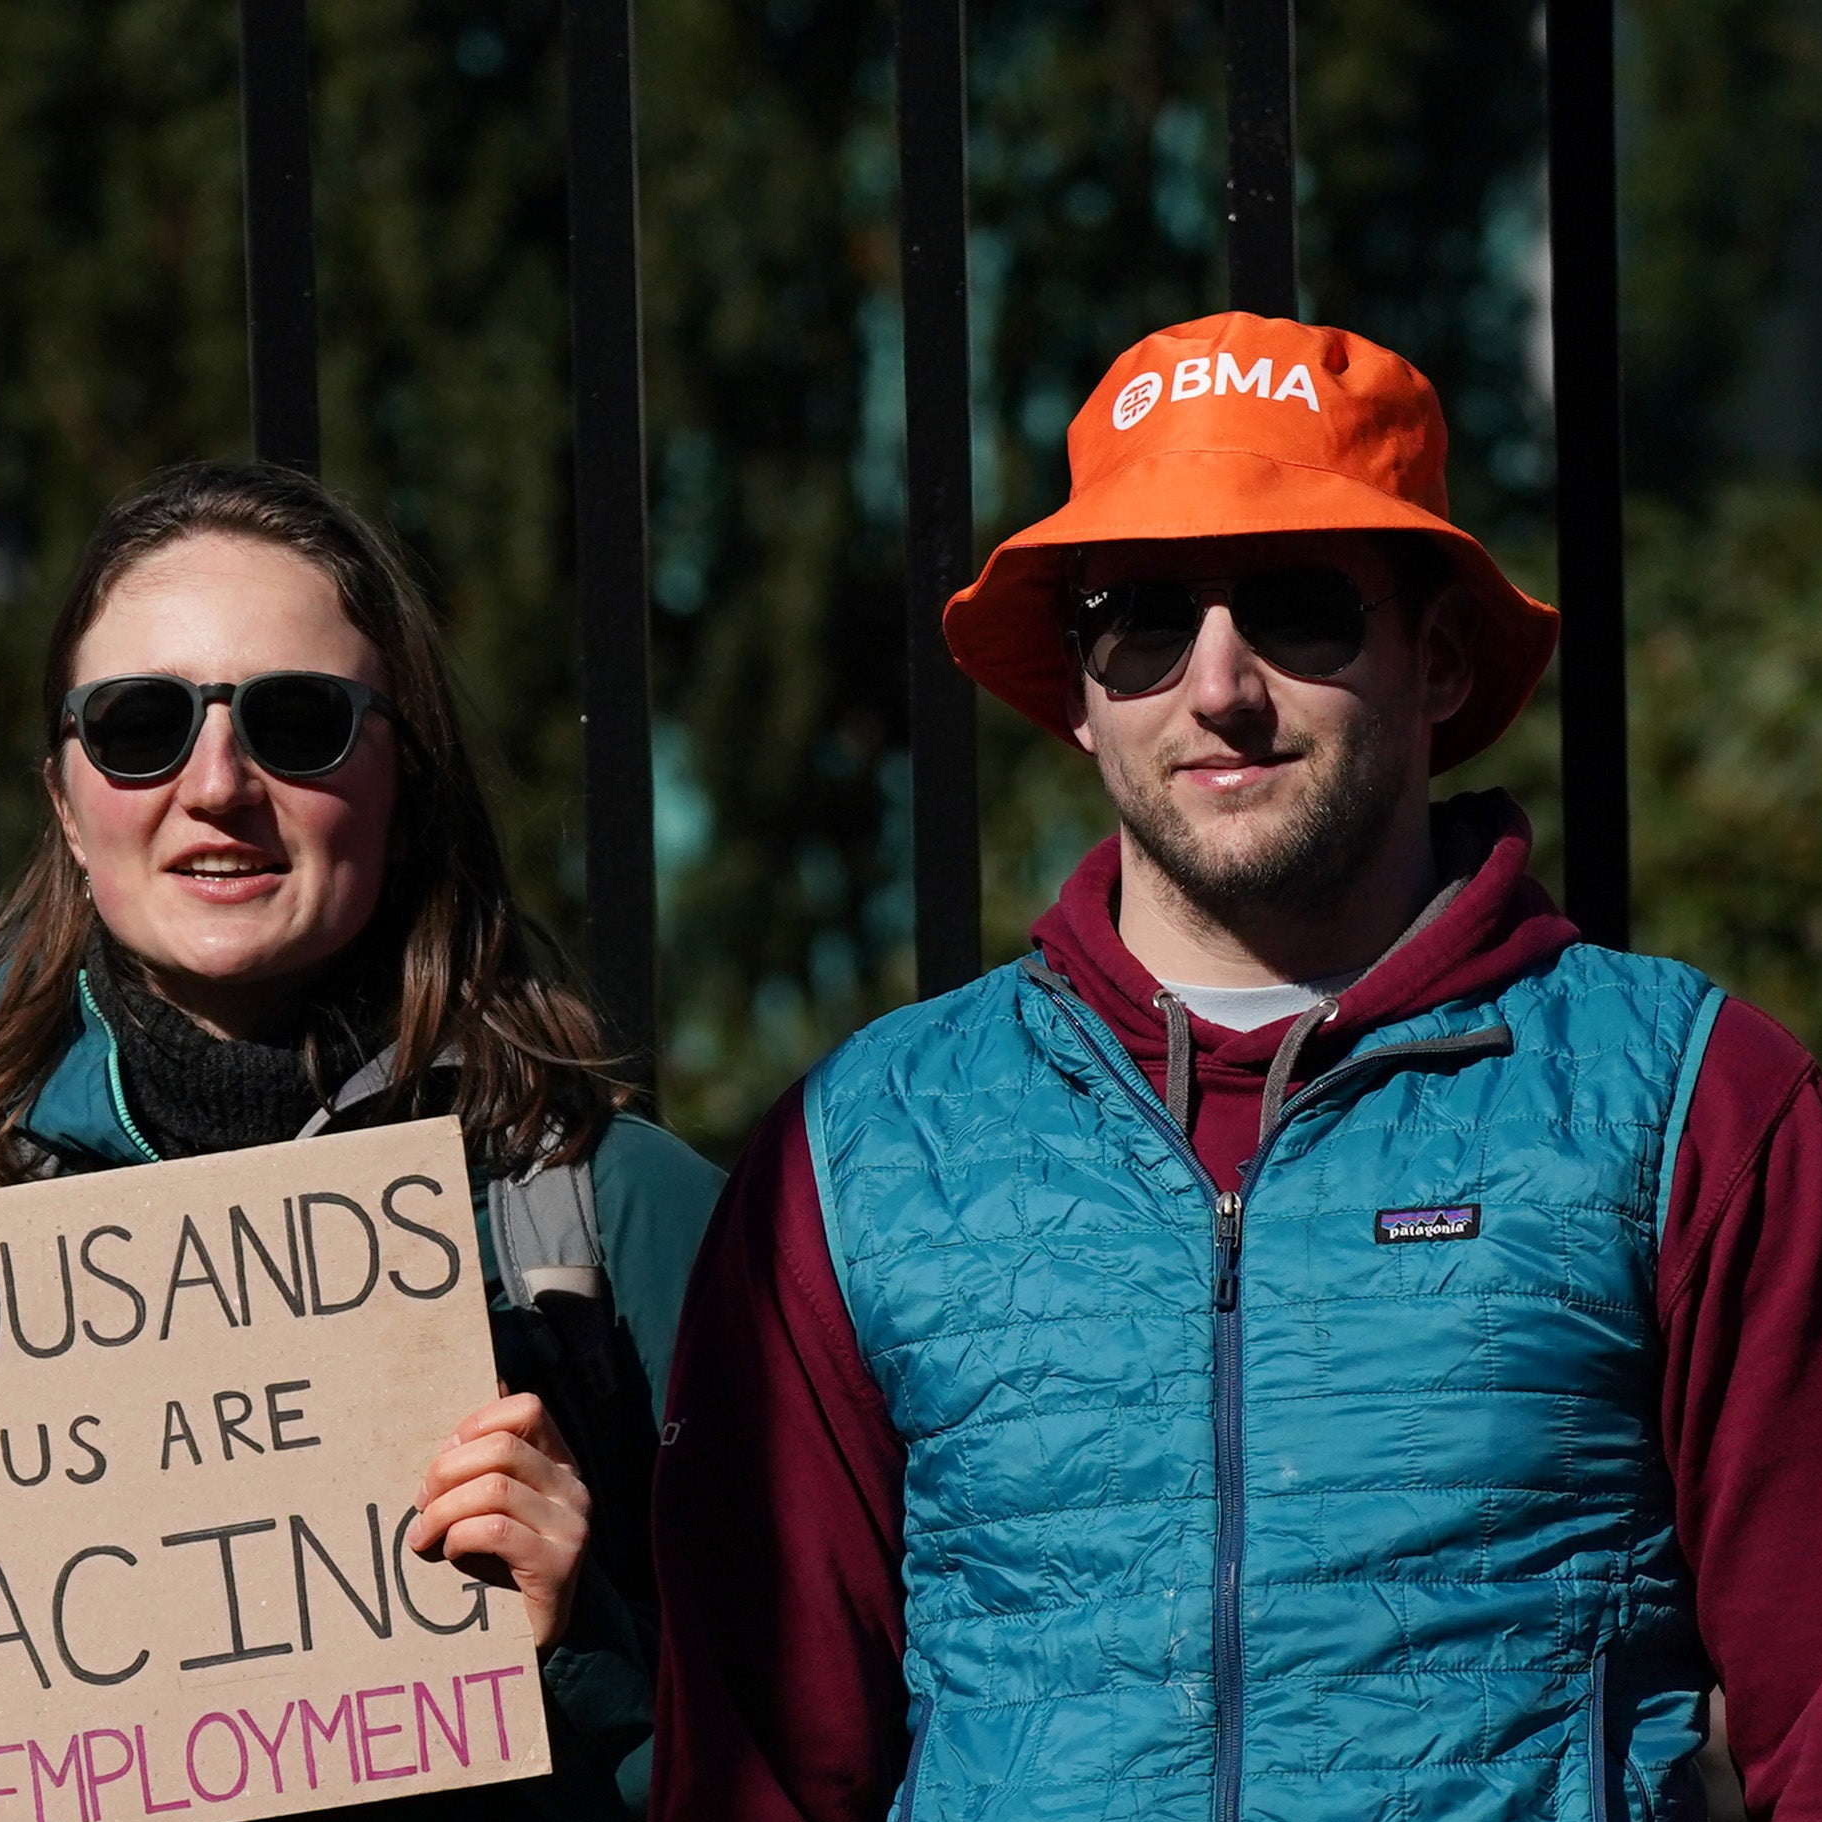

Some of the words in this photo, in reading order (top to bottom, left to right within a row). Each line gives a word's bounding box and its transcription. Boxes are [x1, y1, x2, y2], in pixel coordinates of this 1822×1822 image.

[1170, 352, 1321, 412] BMA
[1389, 1222, 1466, 1239] patagonia
[0, 1414, 109, 1487] US
[159, 1379, 322, 1471] ARE
